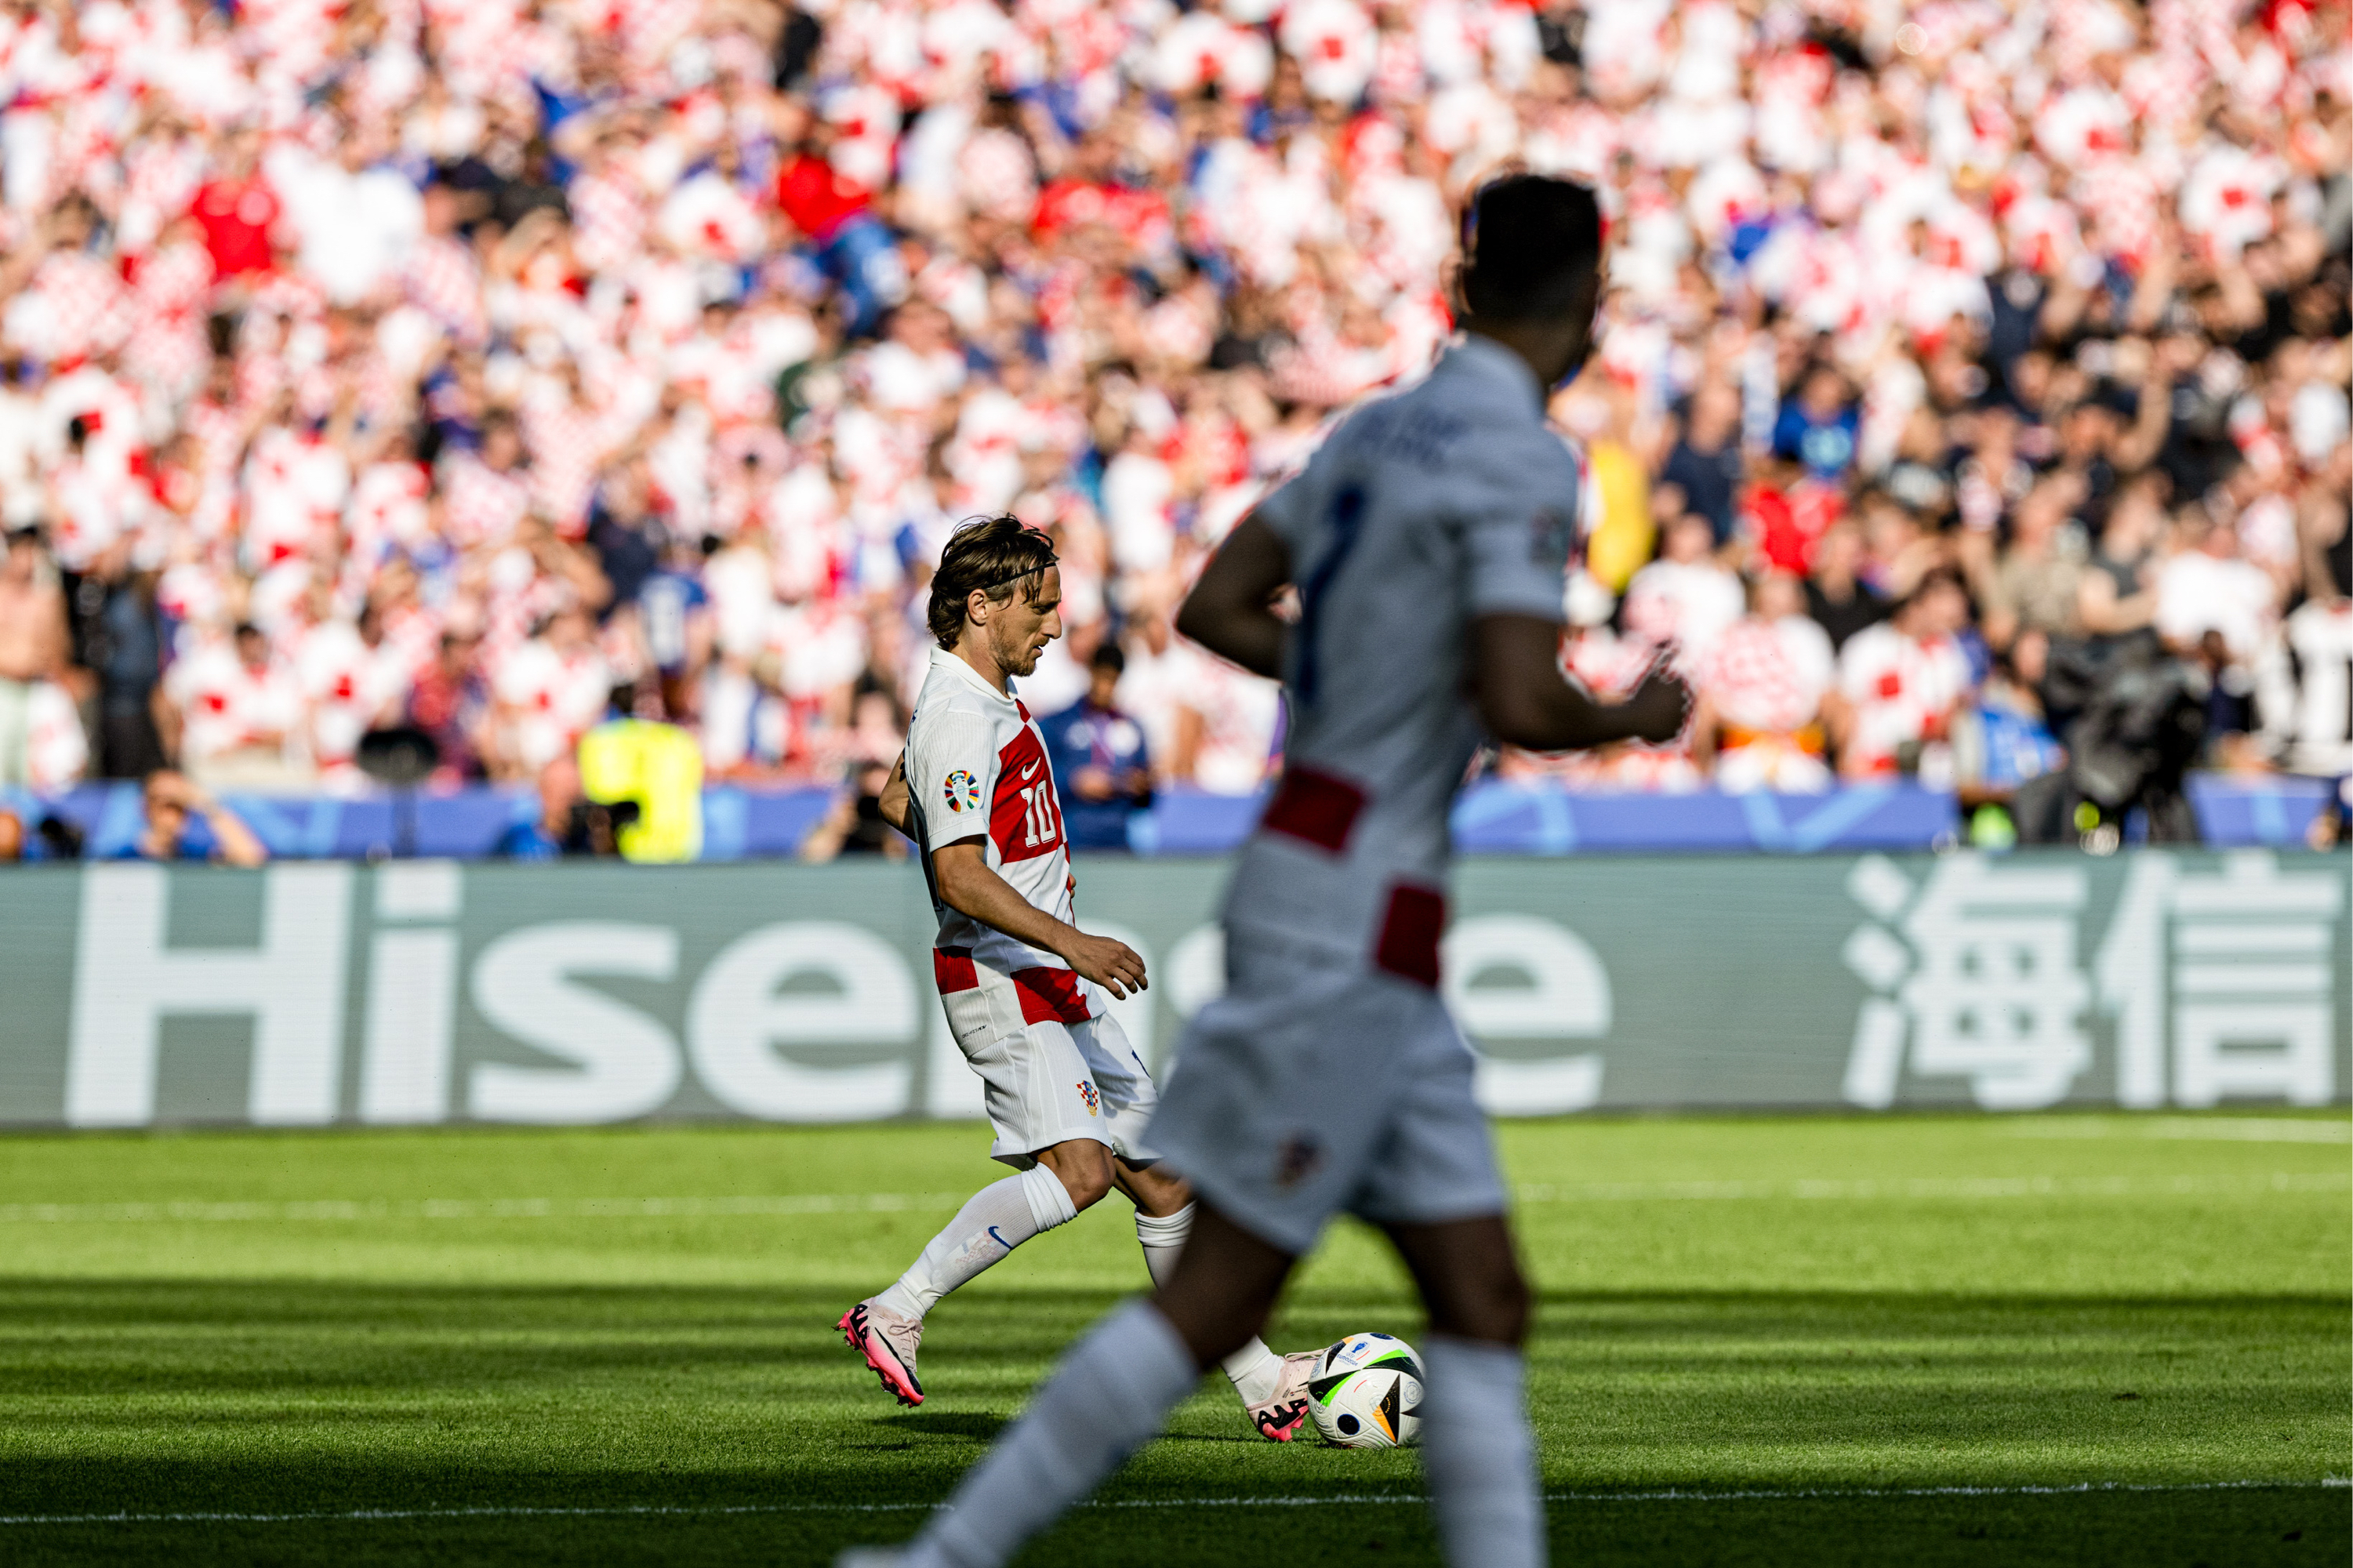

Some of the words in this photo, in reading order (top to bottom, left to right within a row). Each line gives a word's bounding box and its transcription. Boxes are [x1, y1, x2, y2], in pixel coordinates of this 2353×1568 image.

[1019, 779, 1057, 848] 10
[64, 861, 1612, 1127] Hisee
[1843, 848, 2346, 1110] 海信
